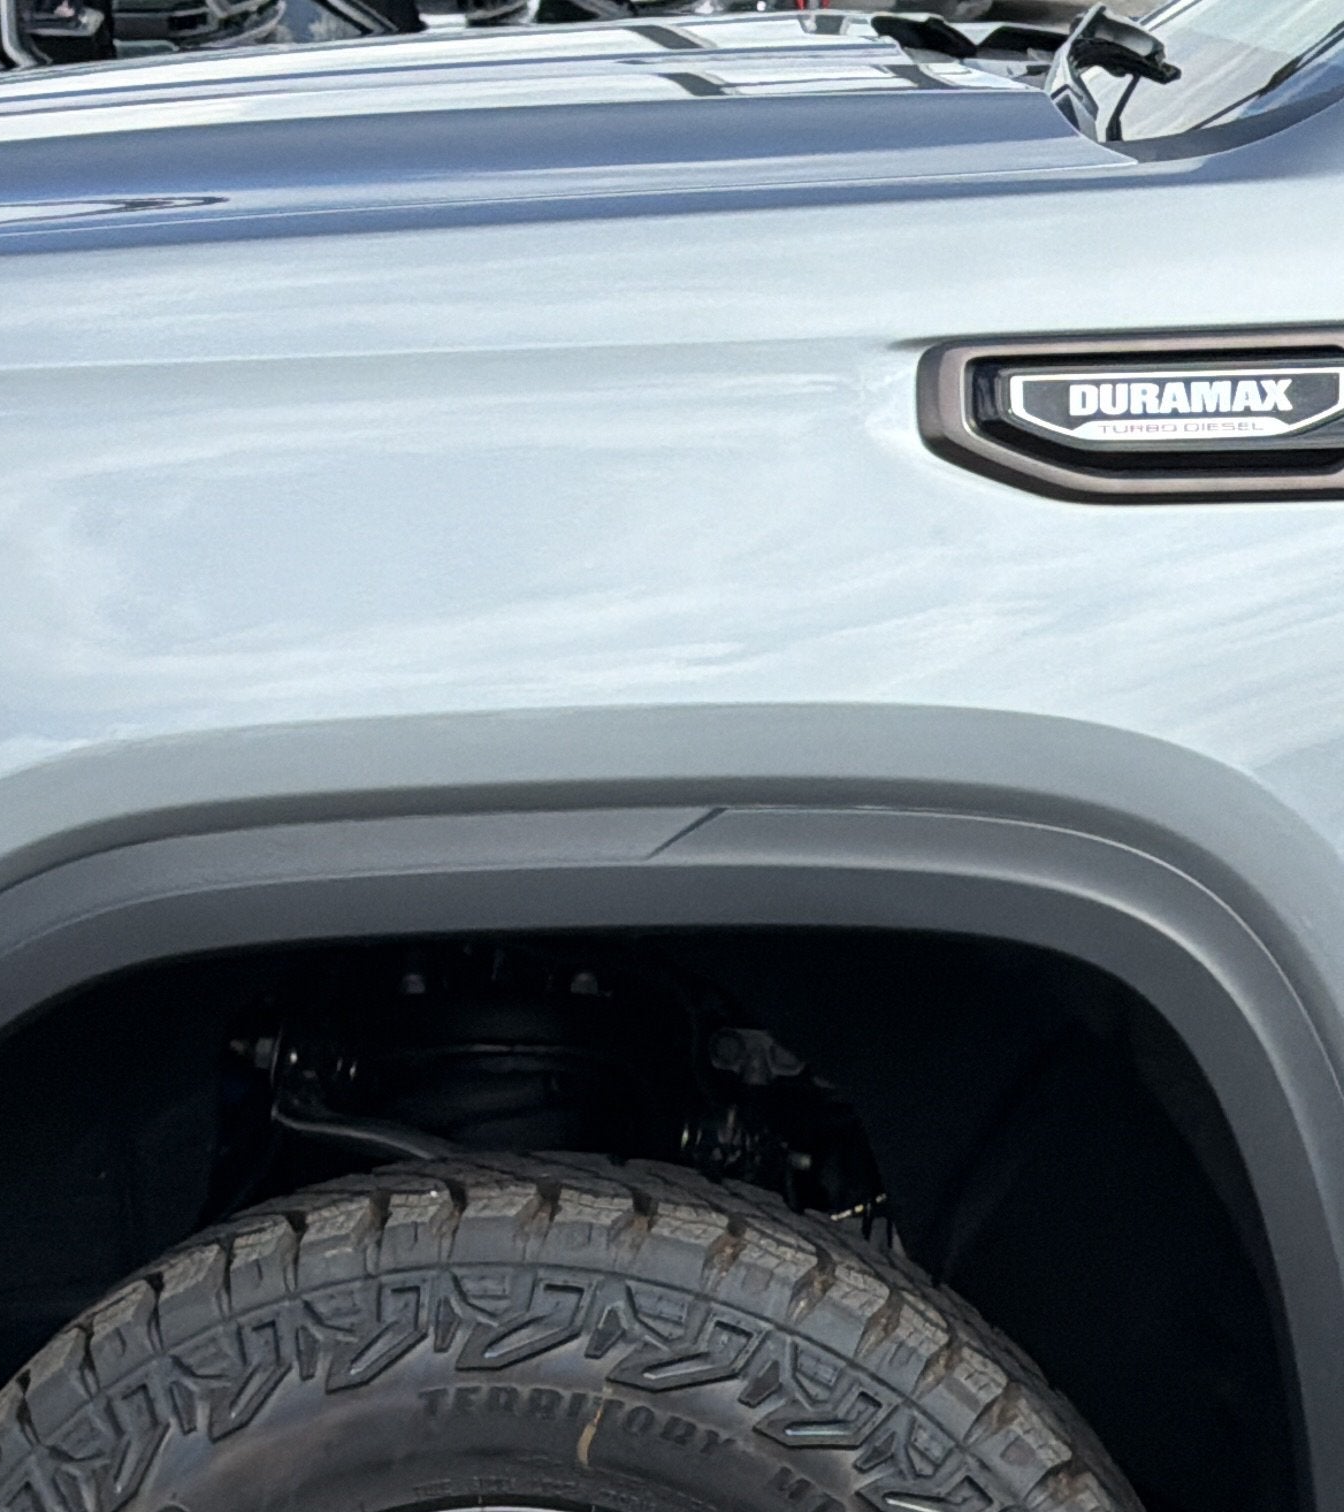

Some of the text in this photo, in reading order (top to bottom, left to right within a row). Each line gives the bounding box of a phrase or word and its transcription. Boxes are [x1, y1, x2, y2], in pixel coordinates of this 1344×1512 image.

[1068, 378, 1294, 417] DURAMAX
[1097, 420, 1264, 434] TURBO DIESEL
[418, 1384, 738, 1455] TERRITORY
